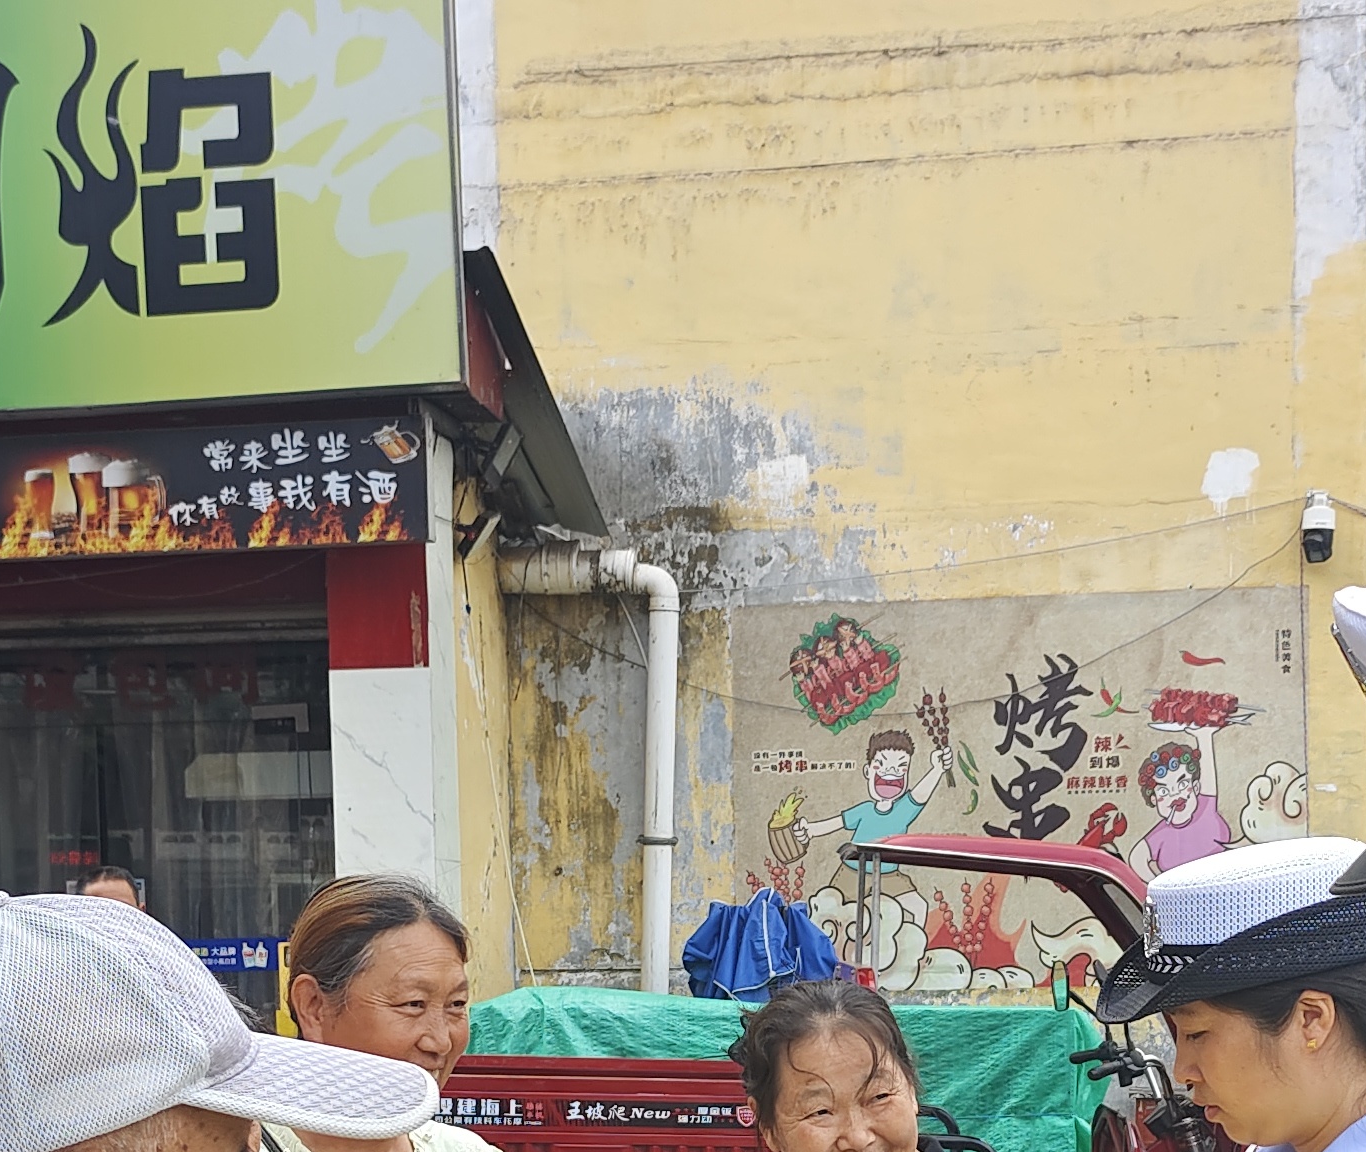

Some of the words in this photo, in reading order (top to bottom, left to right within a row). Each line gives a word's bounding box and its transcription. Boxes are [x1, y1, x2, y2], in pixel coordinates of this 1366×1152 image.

[202, 428, 351, 473] 常来坐坐
[168, 469, 398, 527] 你有故事我有酒
